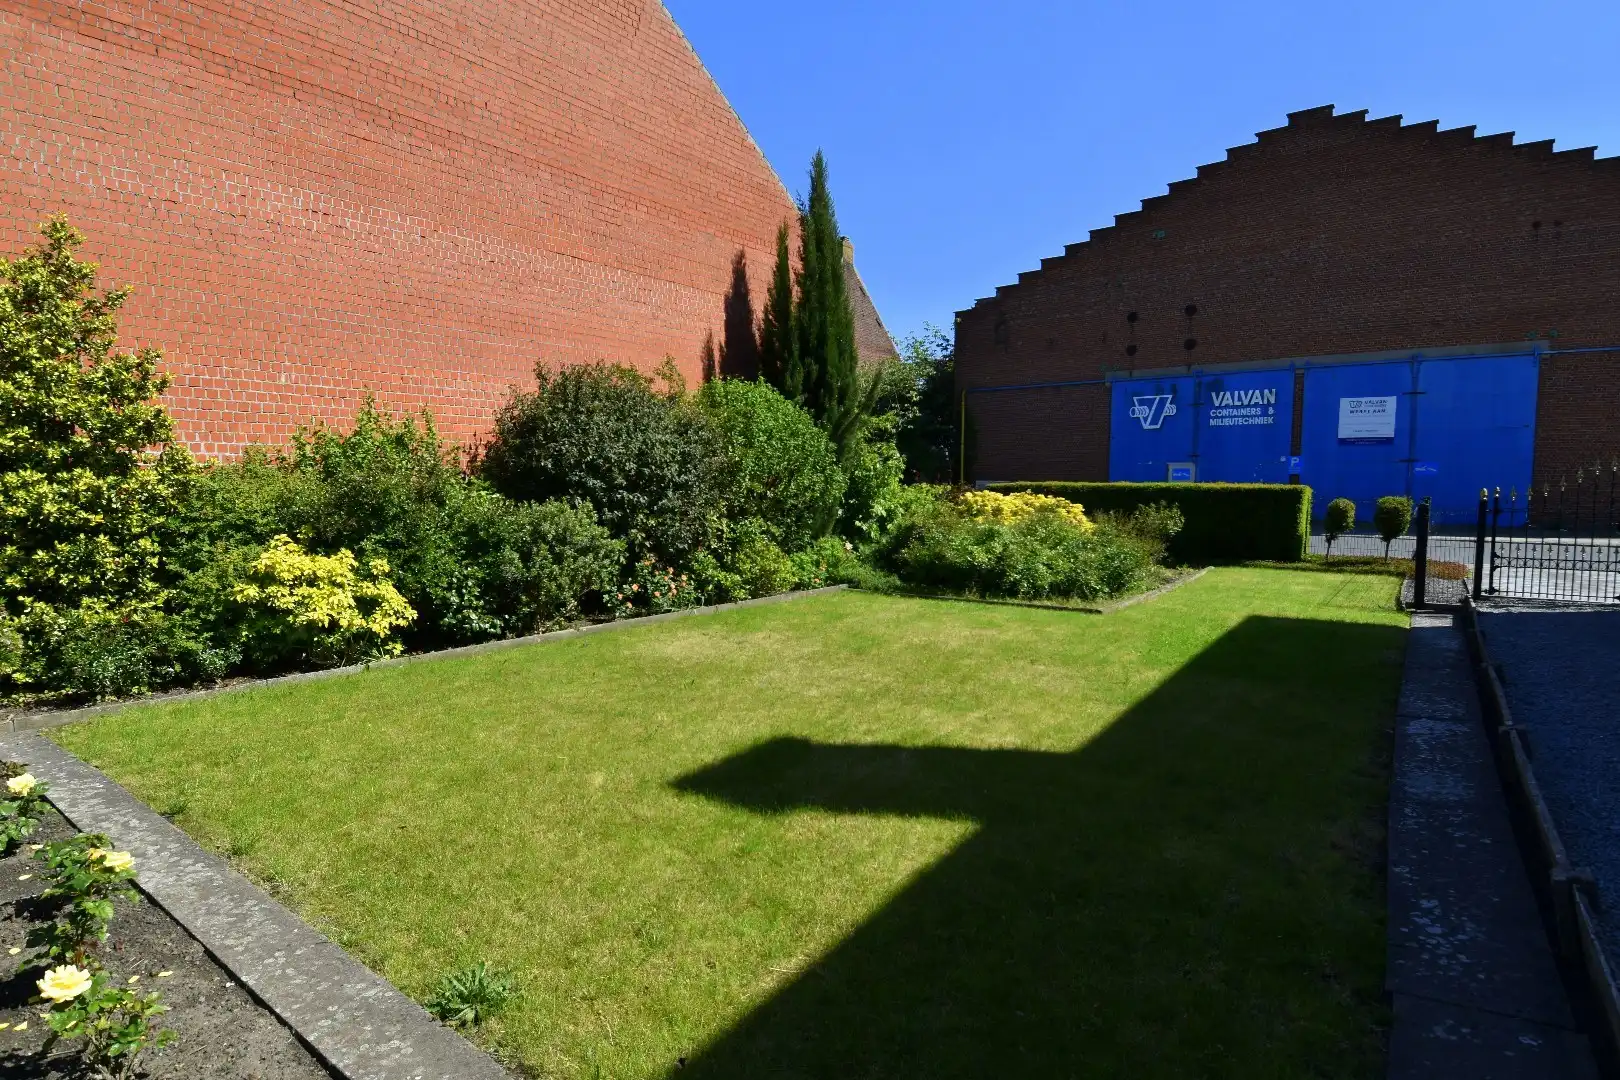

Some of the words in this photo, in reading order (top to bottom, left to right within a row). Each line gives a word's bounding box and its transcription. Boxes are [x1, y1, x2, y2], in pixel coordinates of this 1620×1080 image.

[1211, 388, 1276, 407] VALVAN
[1210, 407, 1261, 417] CONTAINERS
[1268, 406, 1275, 415] &
[1209, 416, 1274, 426] MILIEUTECHNIEK
[1291, 456, 1300, 468] P
